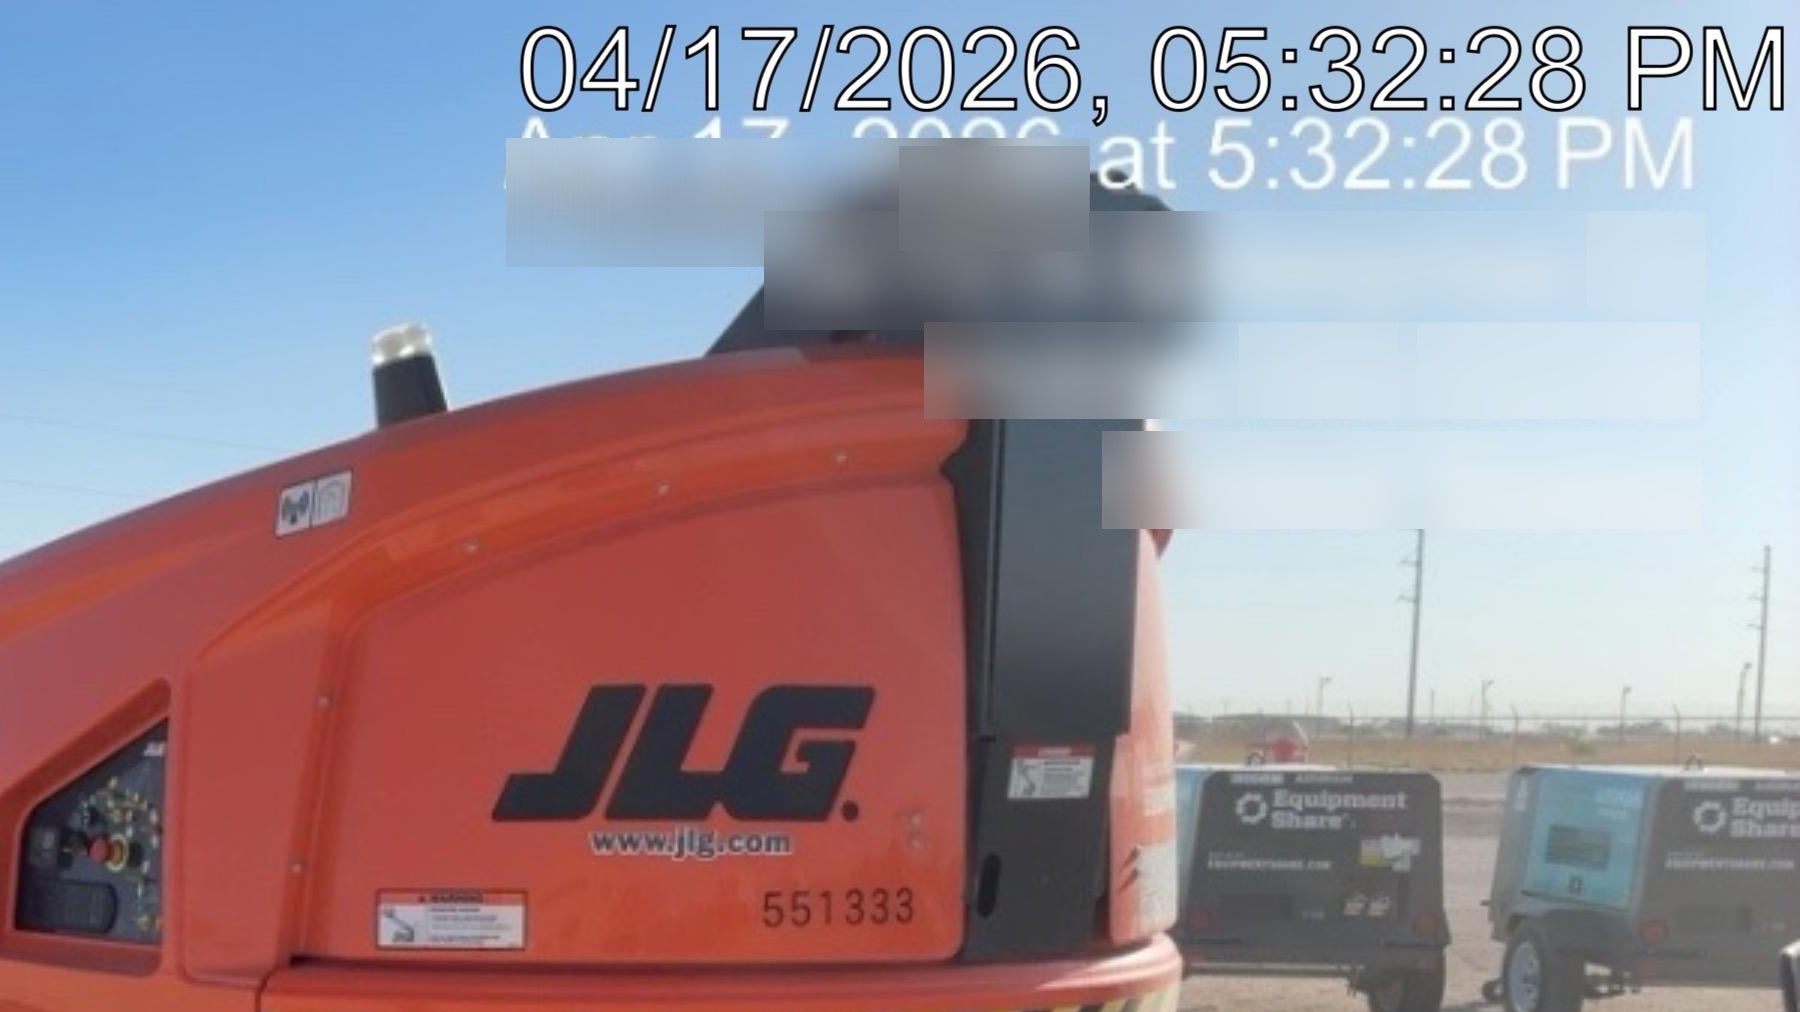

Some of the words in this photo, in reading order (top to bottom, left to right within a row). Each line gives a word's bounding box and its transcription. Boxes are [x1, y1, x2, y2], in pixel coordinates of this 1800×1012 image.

[1271, 788, 1408, 811] Equipment
[589, 826, 793, 861] www.jlg.com
[762, 885, 915, 929] 551333
